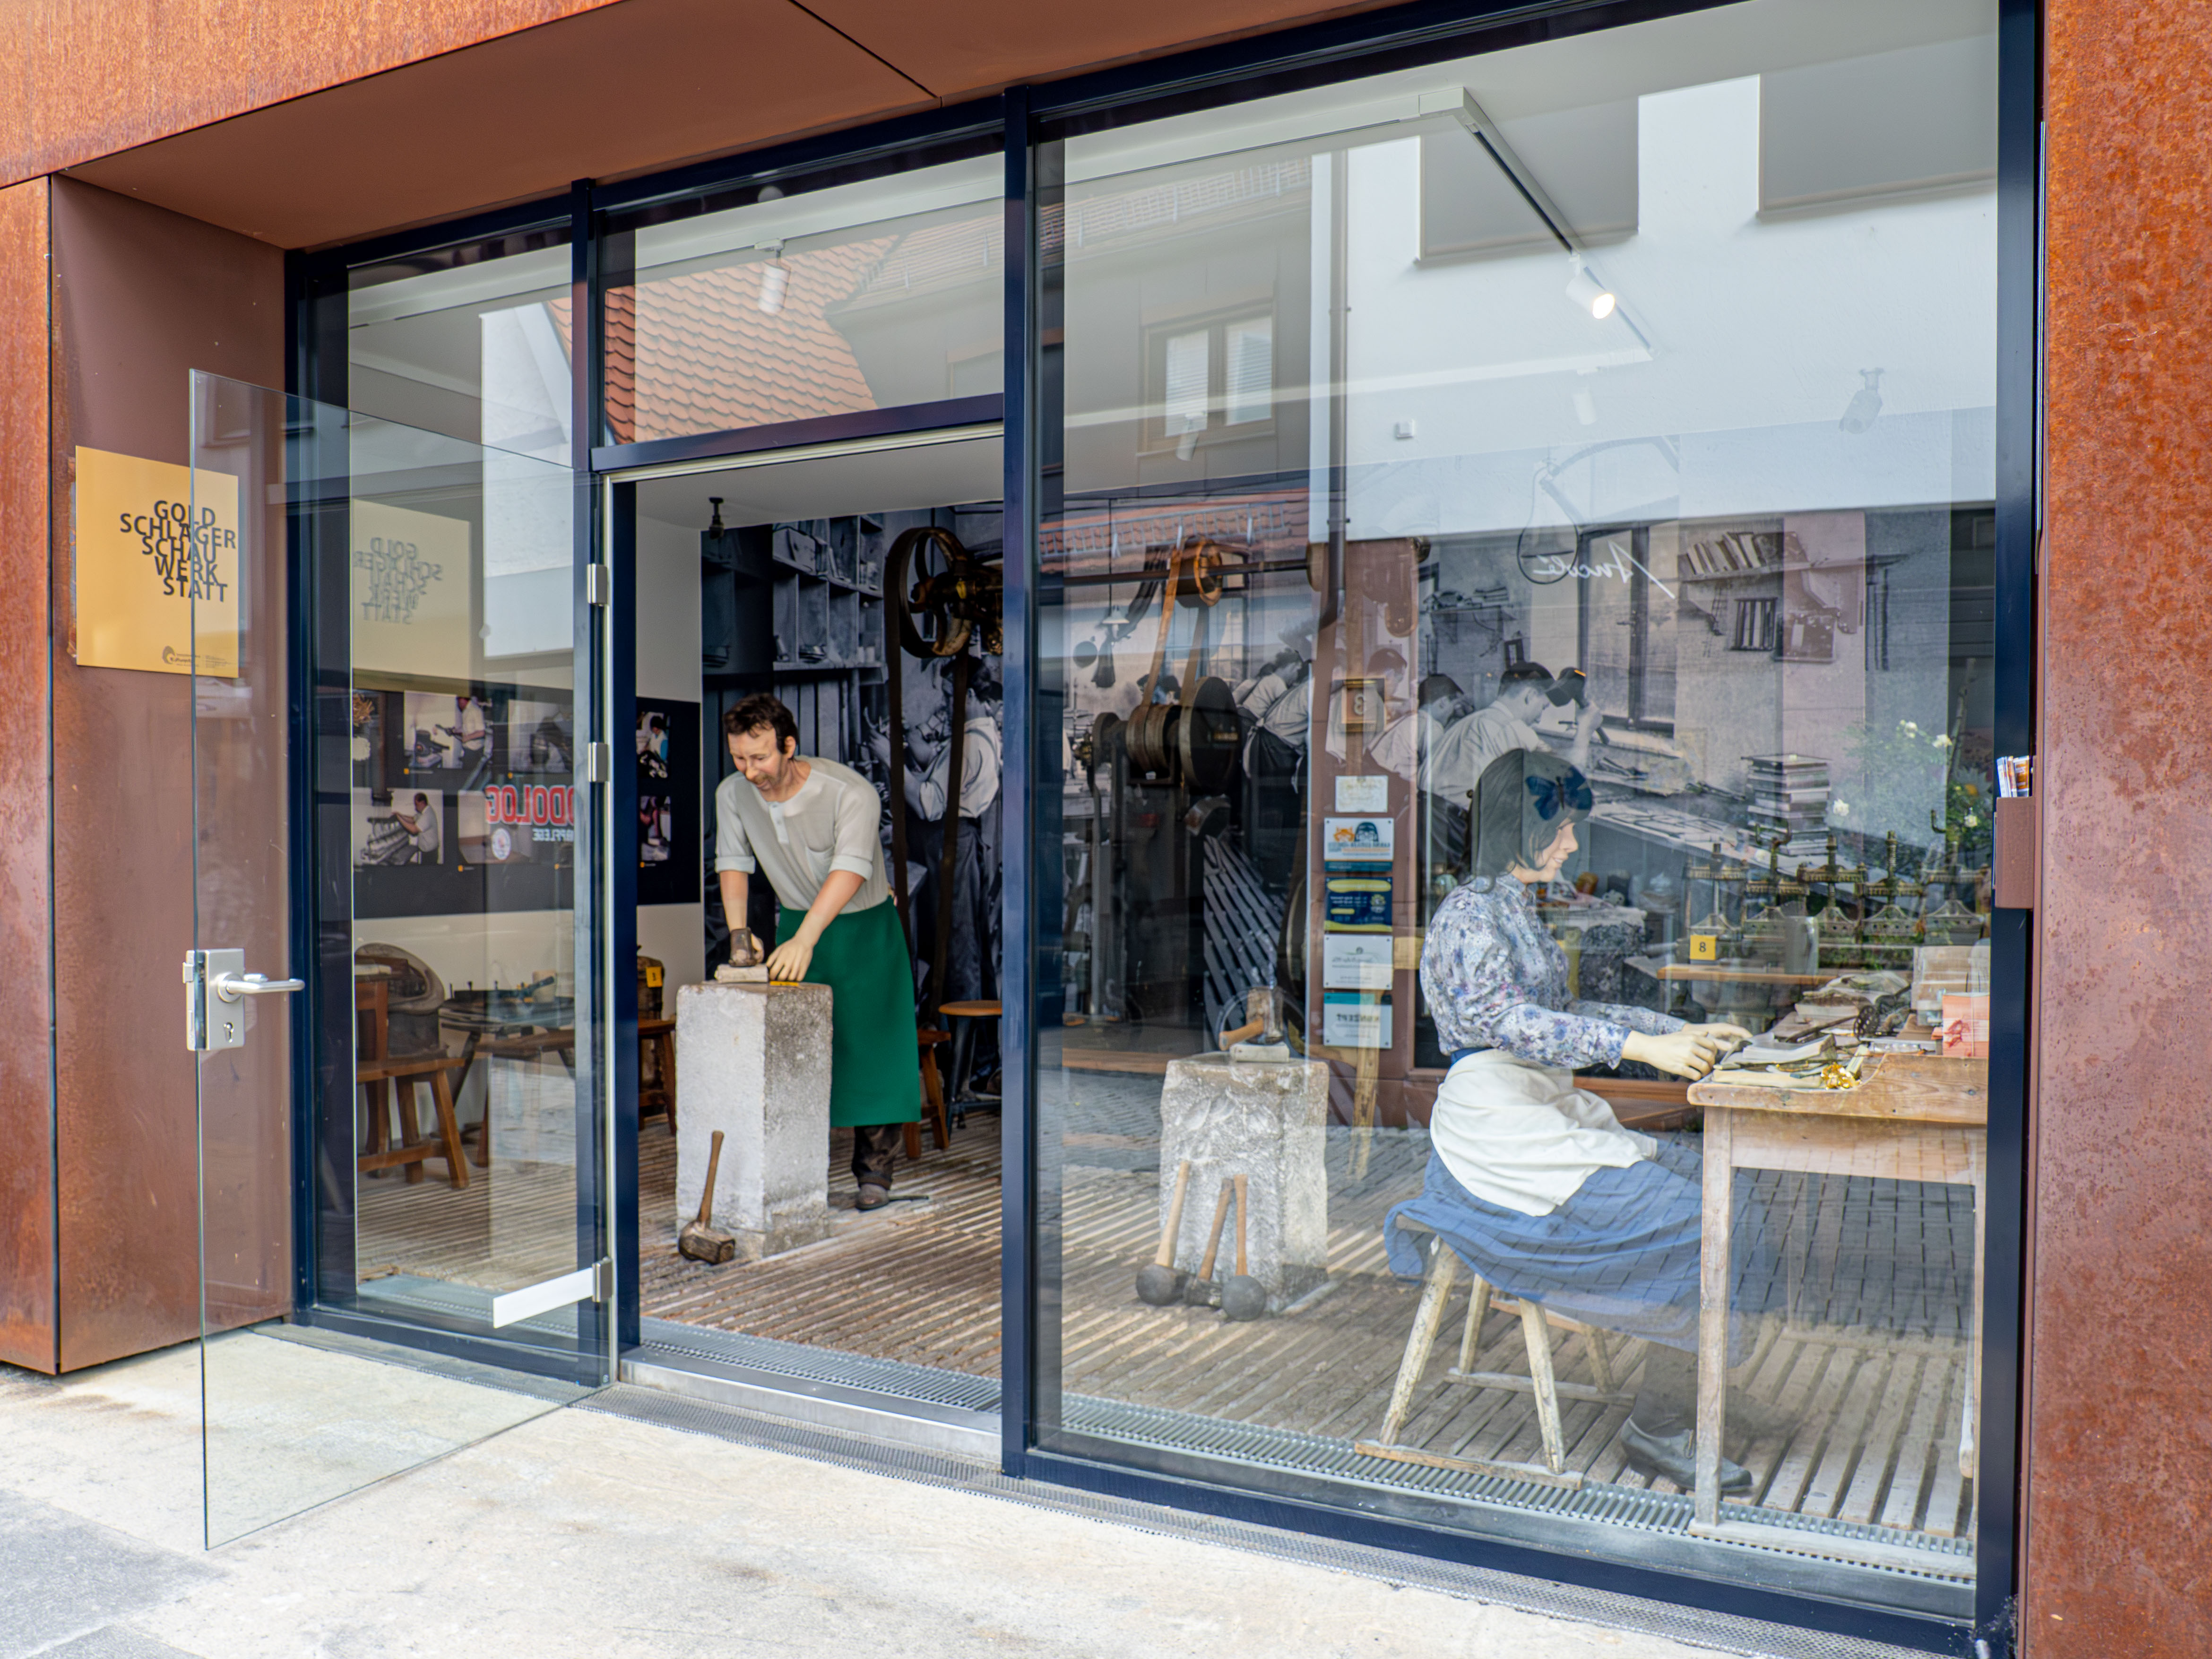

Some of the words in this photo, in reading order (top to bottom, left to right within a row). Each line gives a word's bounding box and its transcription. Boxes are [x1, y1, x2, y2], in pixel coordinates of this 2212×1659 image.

[154, 500, 216, 527] GOLD
[142, 535, 216, 564] SCHAU
[154, 555, 219, 585] WERK
[163, 577, 228, 602] STATT
[1699, 941, 1706, 952] 8
